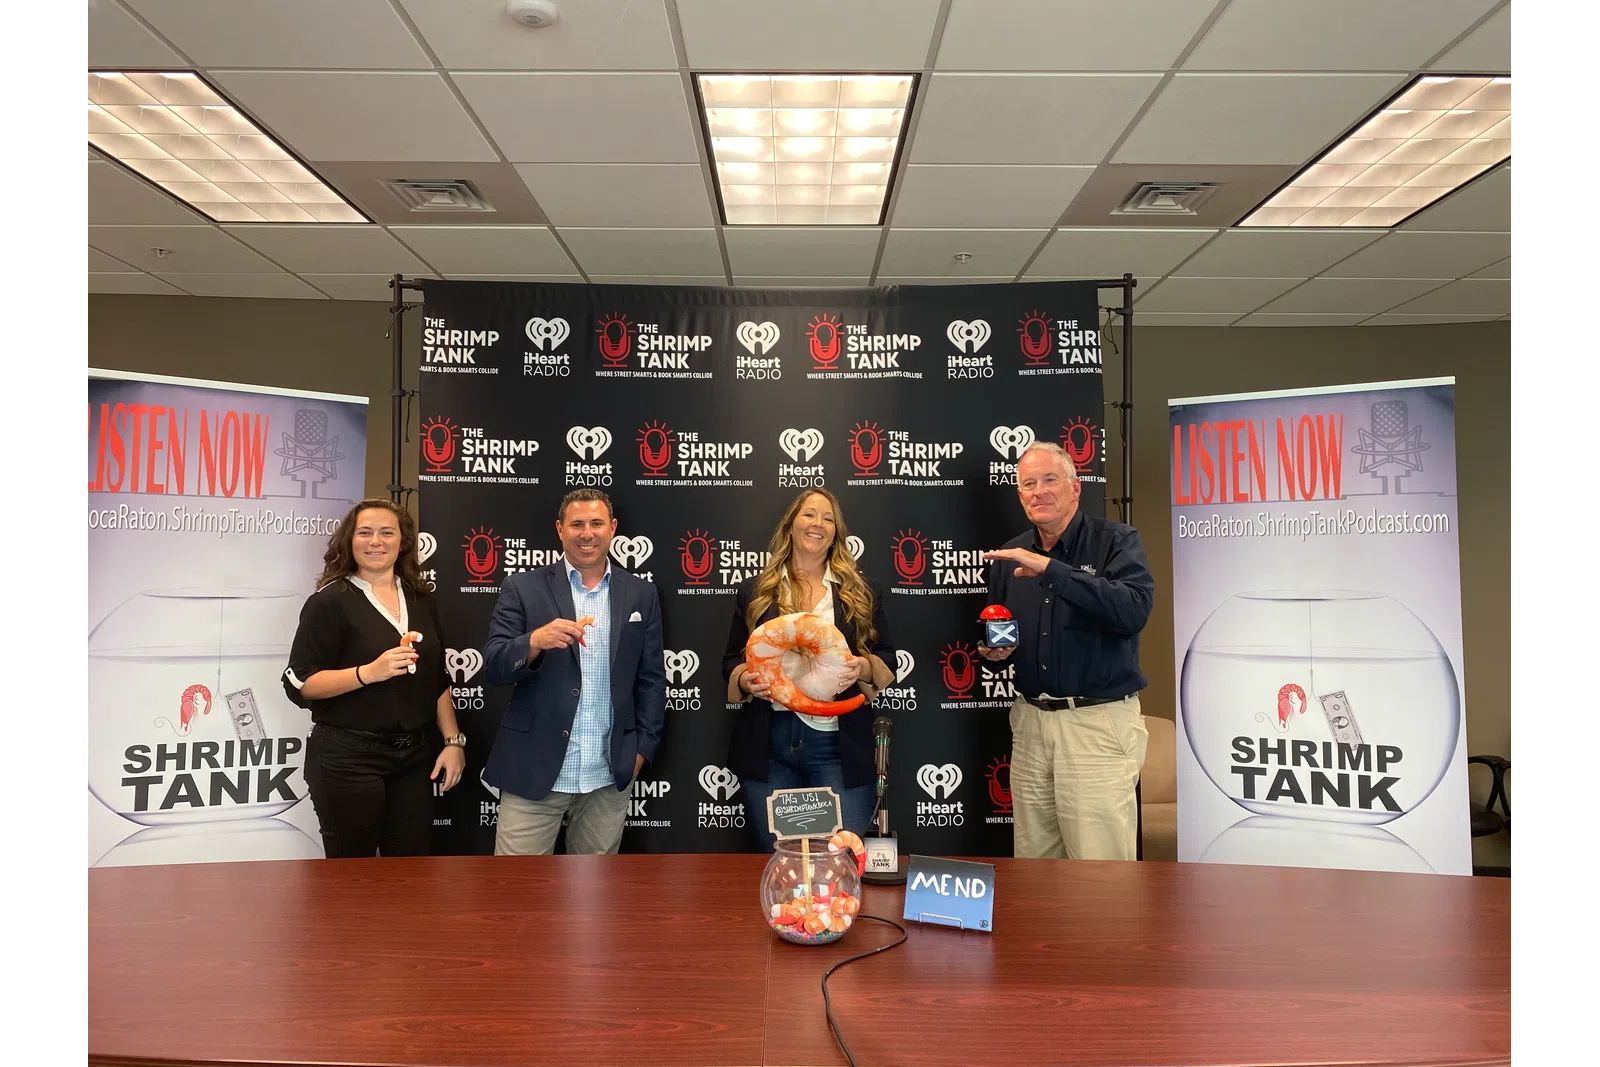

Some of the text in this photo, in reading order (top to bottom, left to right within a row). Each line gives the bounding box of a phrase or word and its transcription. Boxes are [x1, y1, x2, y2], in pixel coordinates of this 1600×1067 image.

[424, 317, 445, 328] THE
[637, 324, 658, 333] THE
[1057, 320, 1078, 329] THE
[847, 325, 867, 334] THE
[423, 329, 499, 346] SHRIMP
[637, 335, 712, 351] SHRIMP
[847, 334, 921, 351] SHRIMP
[1058, 330, 1100, 346] SHRI
[422, 347, 476, 364] TANK
[524, 352, 569, 365] iHeart
[637, 353, 689, 368] TANK
[736, 356, 780, 368] iHeart
[847, 352, 900, 369] TANK
[947, 355, 993, 367] iHeart
[524, 366, 570, 376] RADIO
[737, 369, 781, 380] RADIO
[903, 371, 923, 379] COLLIDE
[948, 367, 994, 379] RADIO
[461, 428, 483, 437] THE
[677, 432, 698, 442] THE
[888, 431, 909, 441] THE
[198, 408, 270, 498] NOW
[461, 438, 539, 456] SHRIMP
[678, 442, 753, 459] SHRIMP
[888, 442, 964, 459] SHRIMP
[461, 457, 516, 474] TANK
[1174, 413, 1344, 505] LISTEN NOW
[566, 461, 612, 474] iHeart
[677, 460, 730, 477] TANK
[779, 464, 824, 476] iHeart
[888, 459, 941, 477] TANK
[990, 462, 1017, 473] iHe
[566, 474, 612, 486] RADIO
[779, 476, 825, 488] RADIO
[990, 474, 1017, 485] RAD
[88, 503, 341, 538] ocaRaton.ShrimpTankPodcast.co
[1179, 508, 1450, 542] BocaRaton.ShrimpTankPodcast.com
[504, 539, 526, 548] THE
[719, 540, 740, 550] THE
[932, 540, 953, 549] THE
[504, 549, 565, 566] SHRIM
[720, 551, 772, 567] SHRI
[719, 569, 763, 585] TAN
[932, 568, 985, 585] TANK
[450, 686, 483, 697] eart
[666, 686, 700, 698] eart
[877, 687, 916, 698] Heart
[982, 681, 1020, 698] TAN
[452, 698, 484, 710] DIO
[665, 699, 701, 710] ADIO
[871, 698, 917, 710] RADIO
[123, 737, 302, 774] SHRIMP
[1231, 736, 1403, 773] SHRIMP
[121, 766, 301, 812] TANK
[1231, 765, 1403, 812] TANK
[779, 794, 798, 805] TAG
[698, 802, 744, 815] iHeart
[916, 802, 963, 814] iHeart
[698, 816, 745, 828] RADIO
[917, 814, 964, 827] RADIO
[910, 871, 986, 899] MEND
